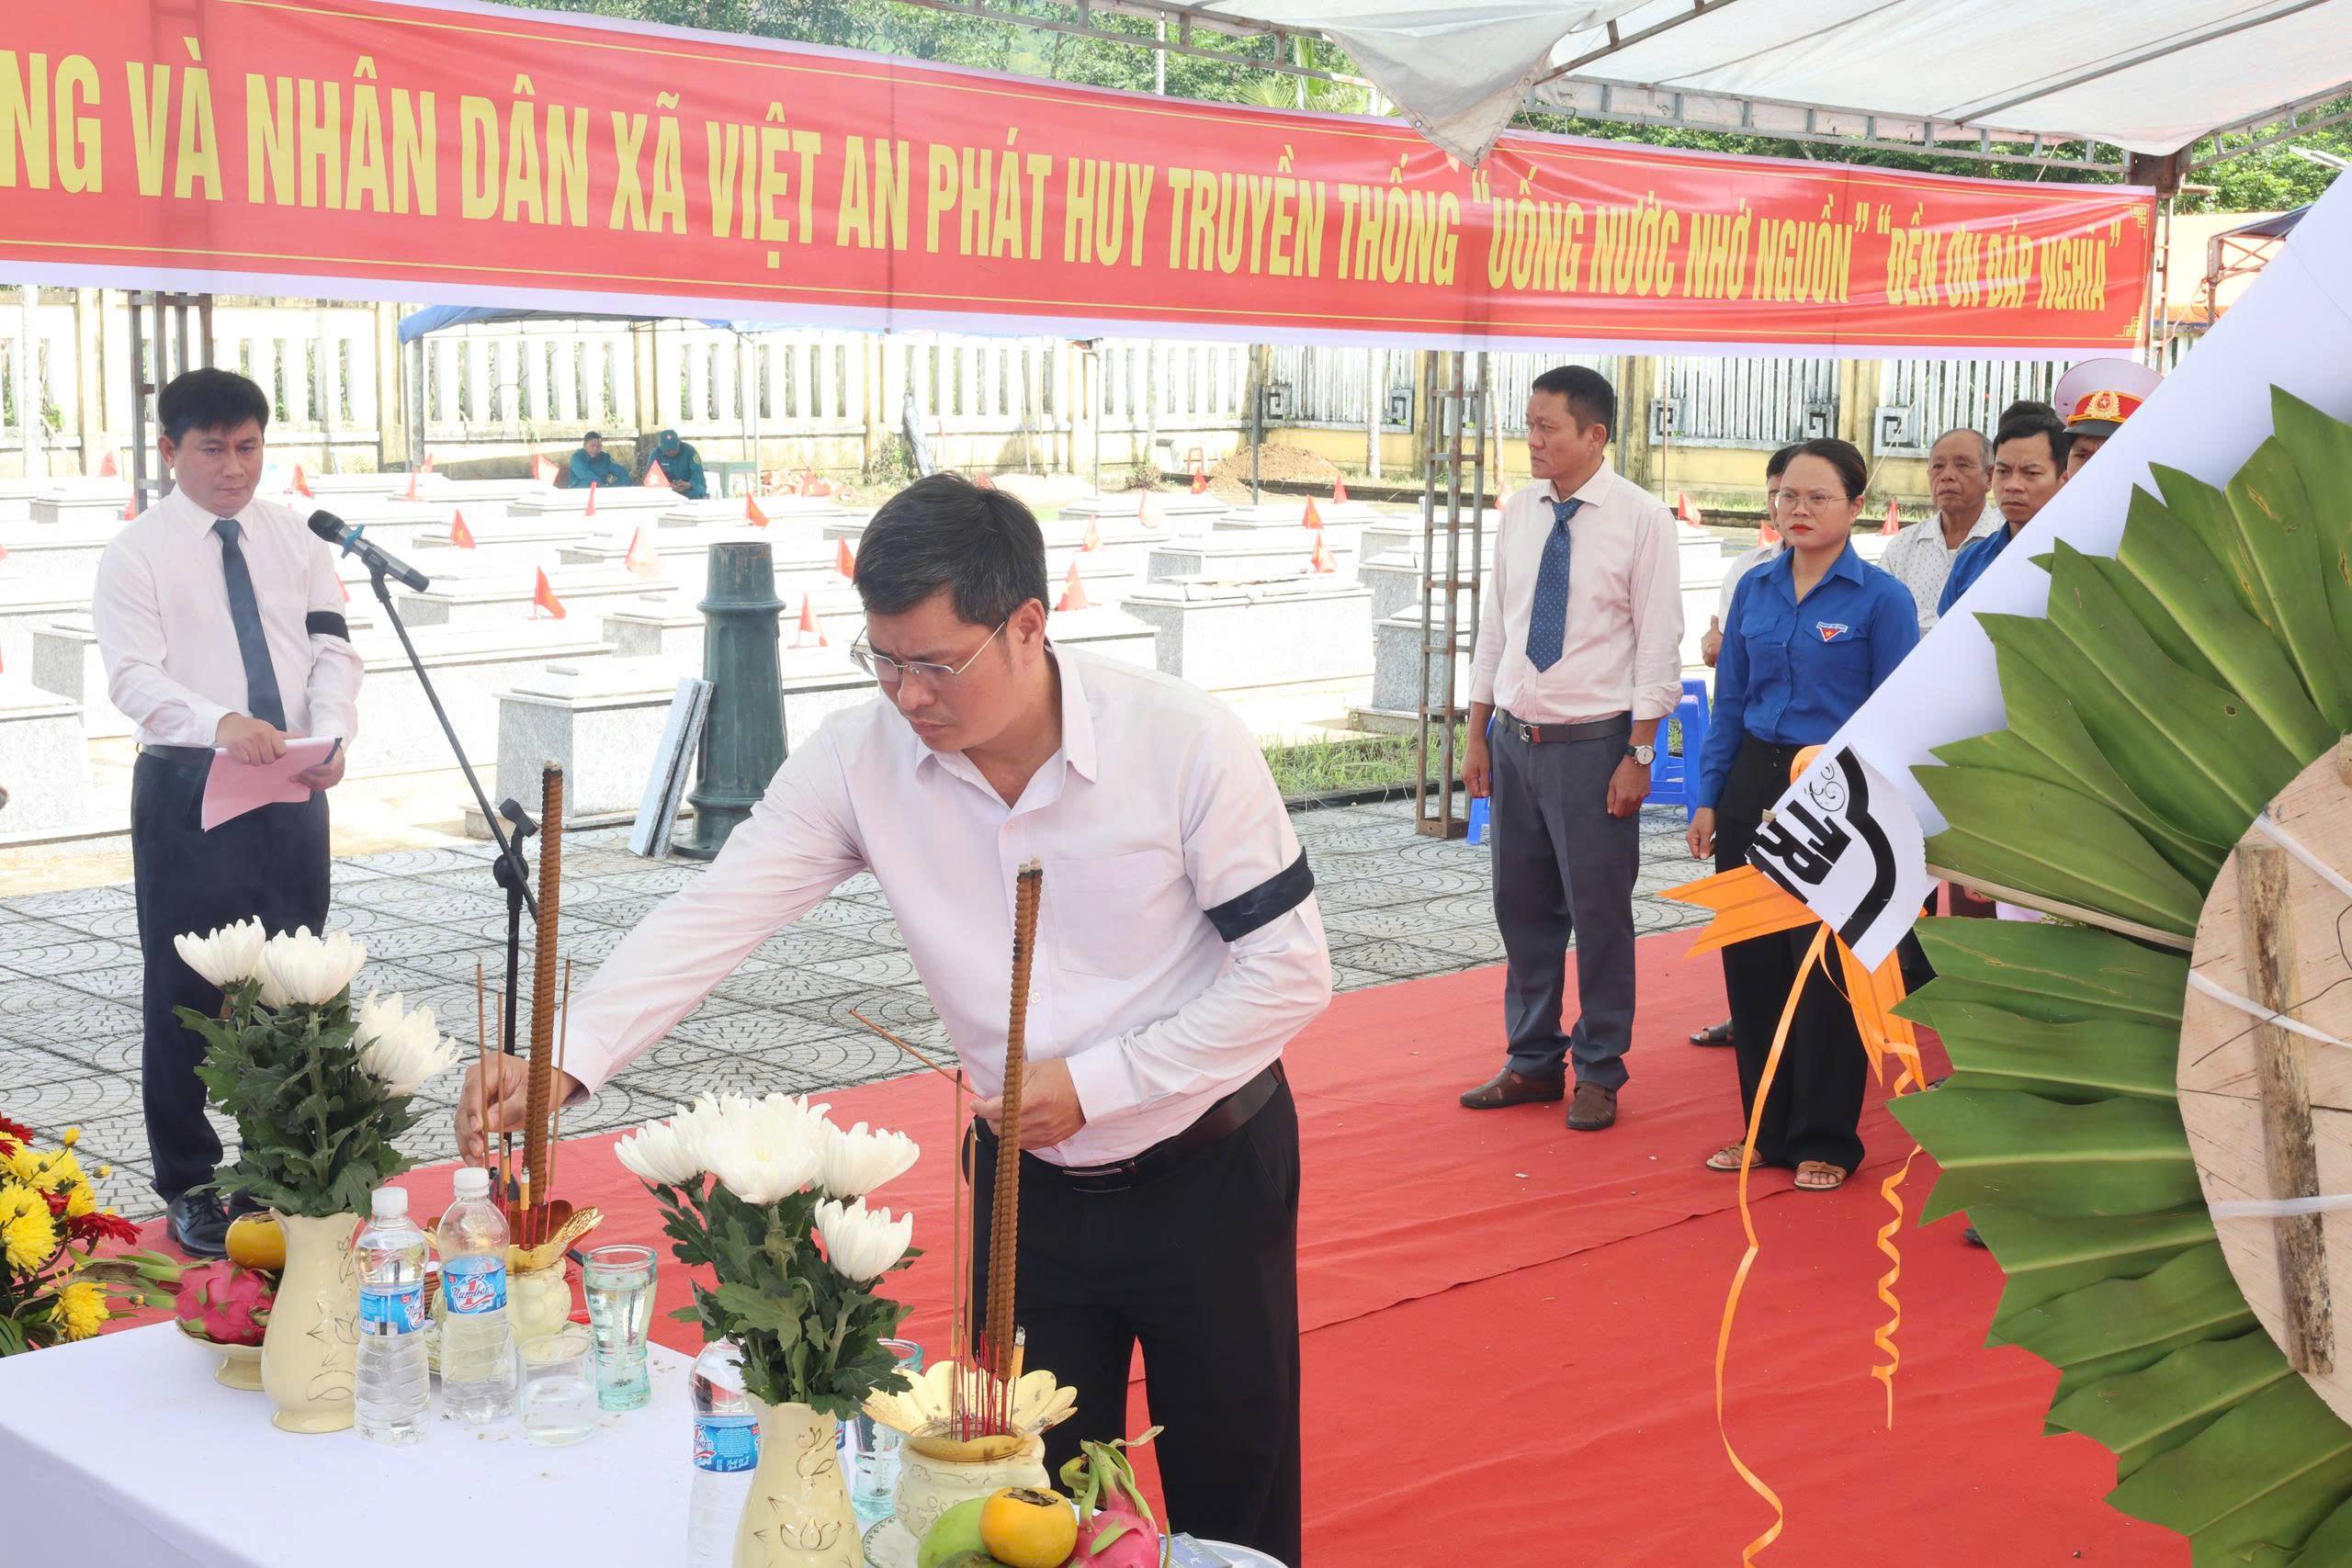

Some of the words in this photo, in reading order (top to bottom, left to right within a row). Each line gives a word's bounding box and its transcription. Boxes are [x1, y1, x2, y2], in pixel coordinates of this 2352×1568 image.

[125, 37, 223, 201] VÀ
[245, 55, 437, 216] NHÂN
[460, 73, 588, 228] DÂN
[608, 91, 687, 235] XÃ
[706, 102, 821, 269] VIỆT
[836, 135, 910, 251] AN
[926, 127, 1053, 261] PHÁT
[1063, 157, 1155, 267] HUY
[1168, 144, 1326, 278] TRUYỀN
[1337, 153, 1461, 286] THỐNG
[1588, 190, 1679, 298] NƯỚC
[1683, 197, 1752, 300] NHỚ
[1944, 223, 1983, 308] ƠN
[1984, 219, 2034, 309] ĐÁP
